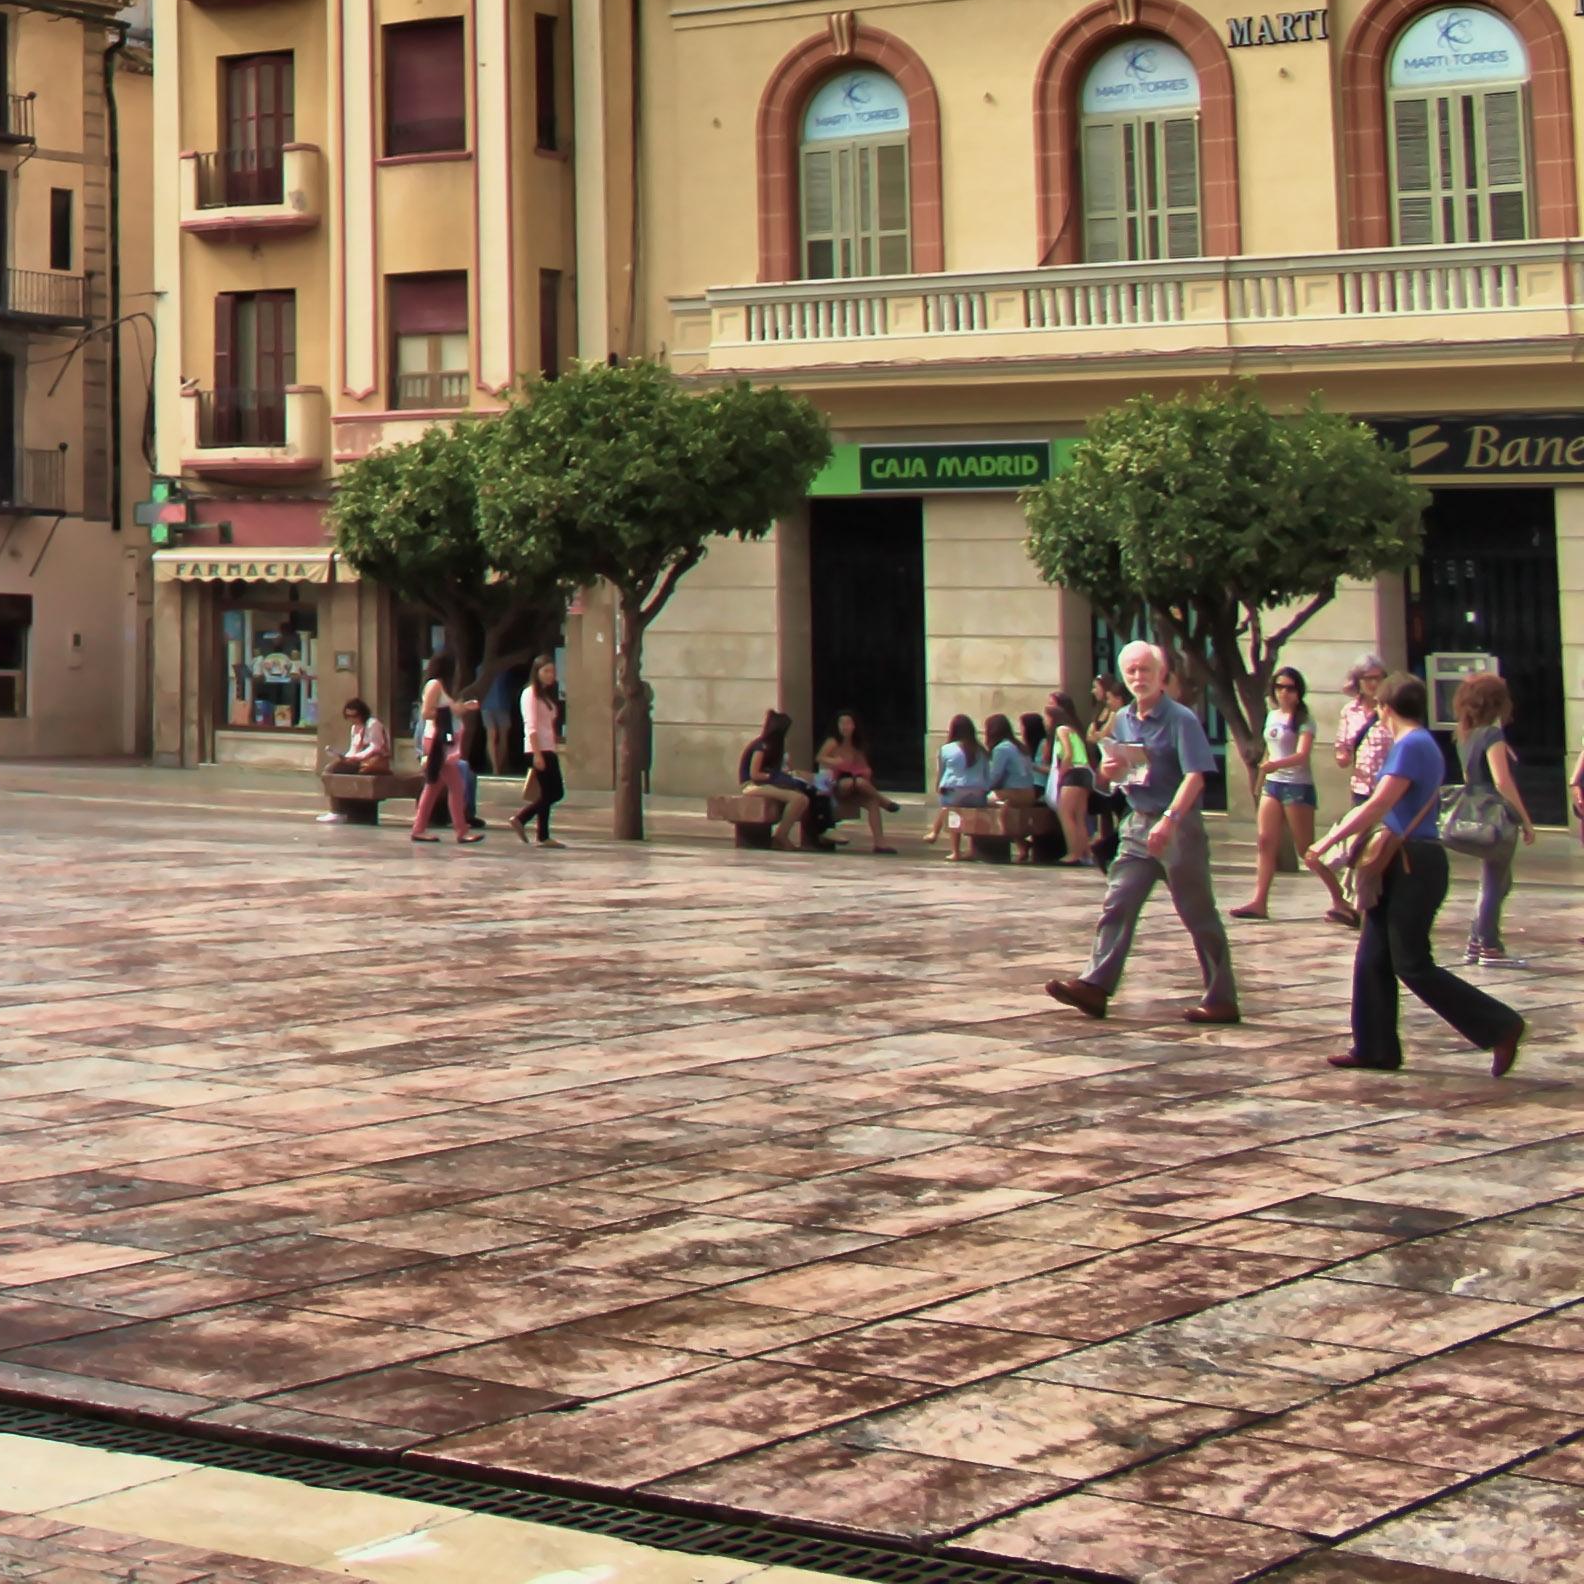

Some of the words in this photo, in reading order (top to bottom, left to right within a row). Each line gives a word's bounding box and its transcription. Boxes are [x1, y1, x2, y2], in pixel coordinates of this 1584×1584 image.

[1226, 9, 1329, 48] MARTI
[1404, 53, 1449, 70] MARTI
[1453, 49, 1509, 66] TORRES
[1095, 83, 1135, 98] MARTI
[1139, 78, 1189, 94] TORRES
[856, 107, 900, 123] TORRES
[870, 456, 928, 479] CAJA
[936, 455, 1040, 478] MADRID
[176, 562, 307, 577] FARMACIA
